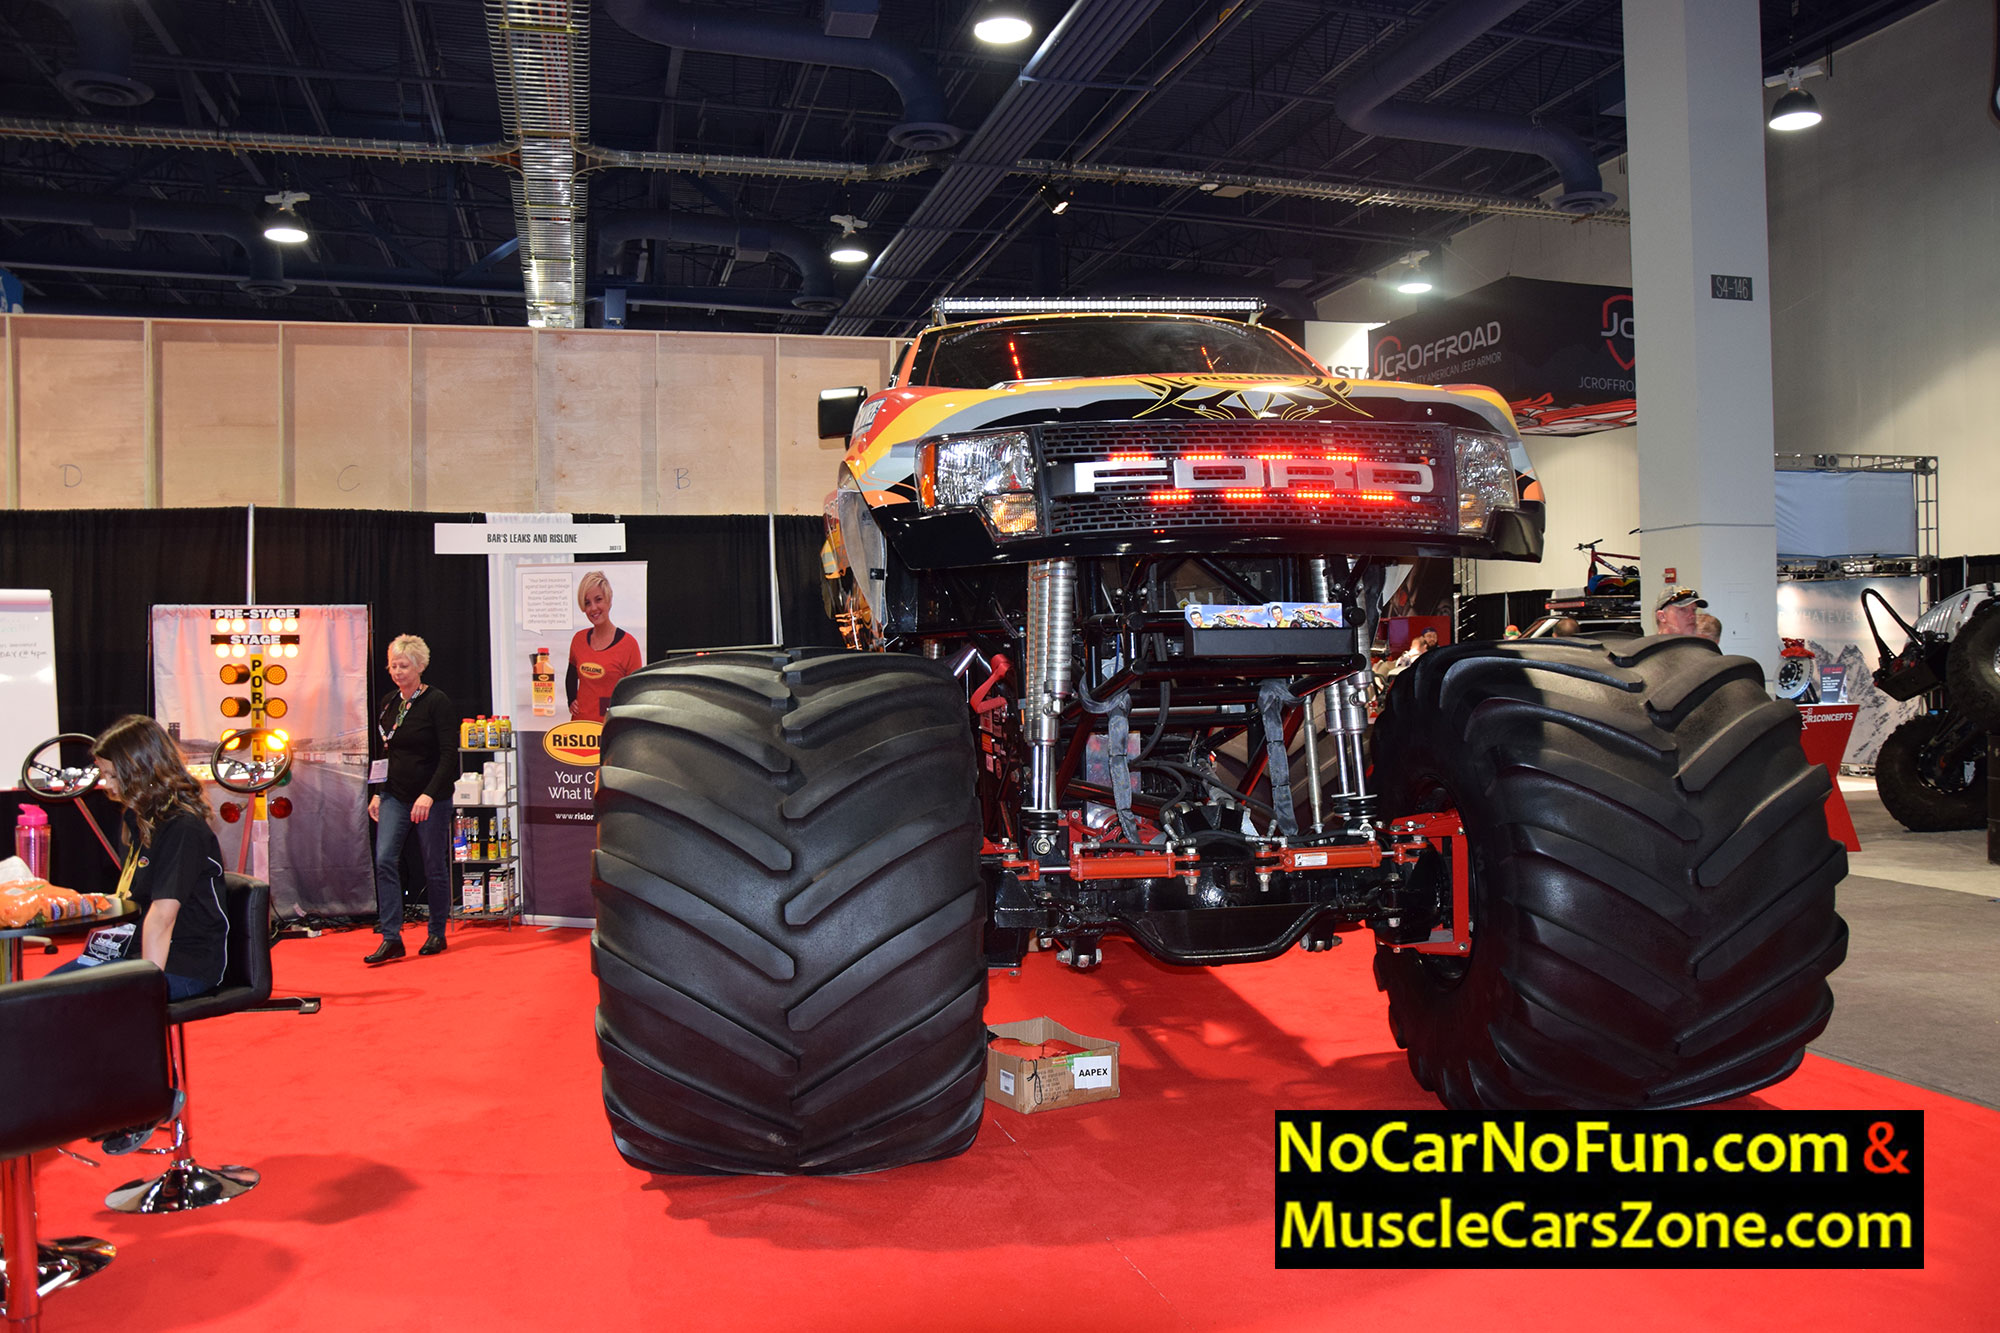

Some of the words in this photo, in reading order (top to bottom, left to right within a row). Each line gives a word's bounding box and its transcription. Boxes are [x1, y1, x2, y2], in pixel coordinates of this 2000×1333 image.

[1716, 276, 1749, 300] S4-146
[1426, 364, 1461, 382] AMERICAN
[1460, 359, 1476, 374] JEEP
[1476, 352, 1502, 367] ARMOR
[1578, 376, 1636, 392] JCROFFRO
[1074, 458, 1434, 494] FORD
[487, 533, 508, 544] BAR'S
[509, 533, 531, 544] LEAKS
[533, 533, 548, 544] AND
[549, 533, 578, 544] RISLONE
[215, 609, 296, 619] PRE-STAGE
[230, 635, 281, 645] STAGE
[554, 771, 583, 784] Your
[584, 771, 595, 784] C
[548, 786, 582, 800] What
[584, 787, 592, 800] It
[1078, 1067, 1108, 1078] AAPEX
